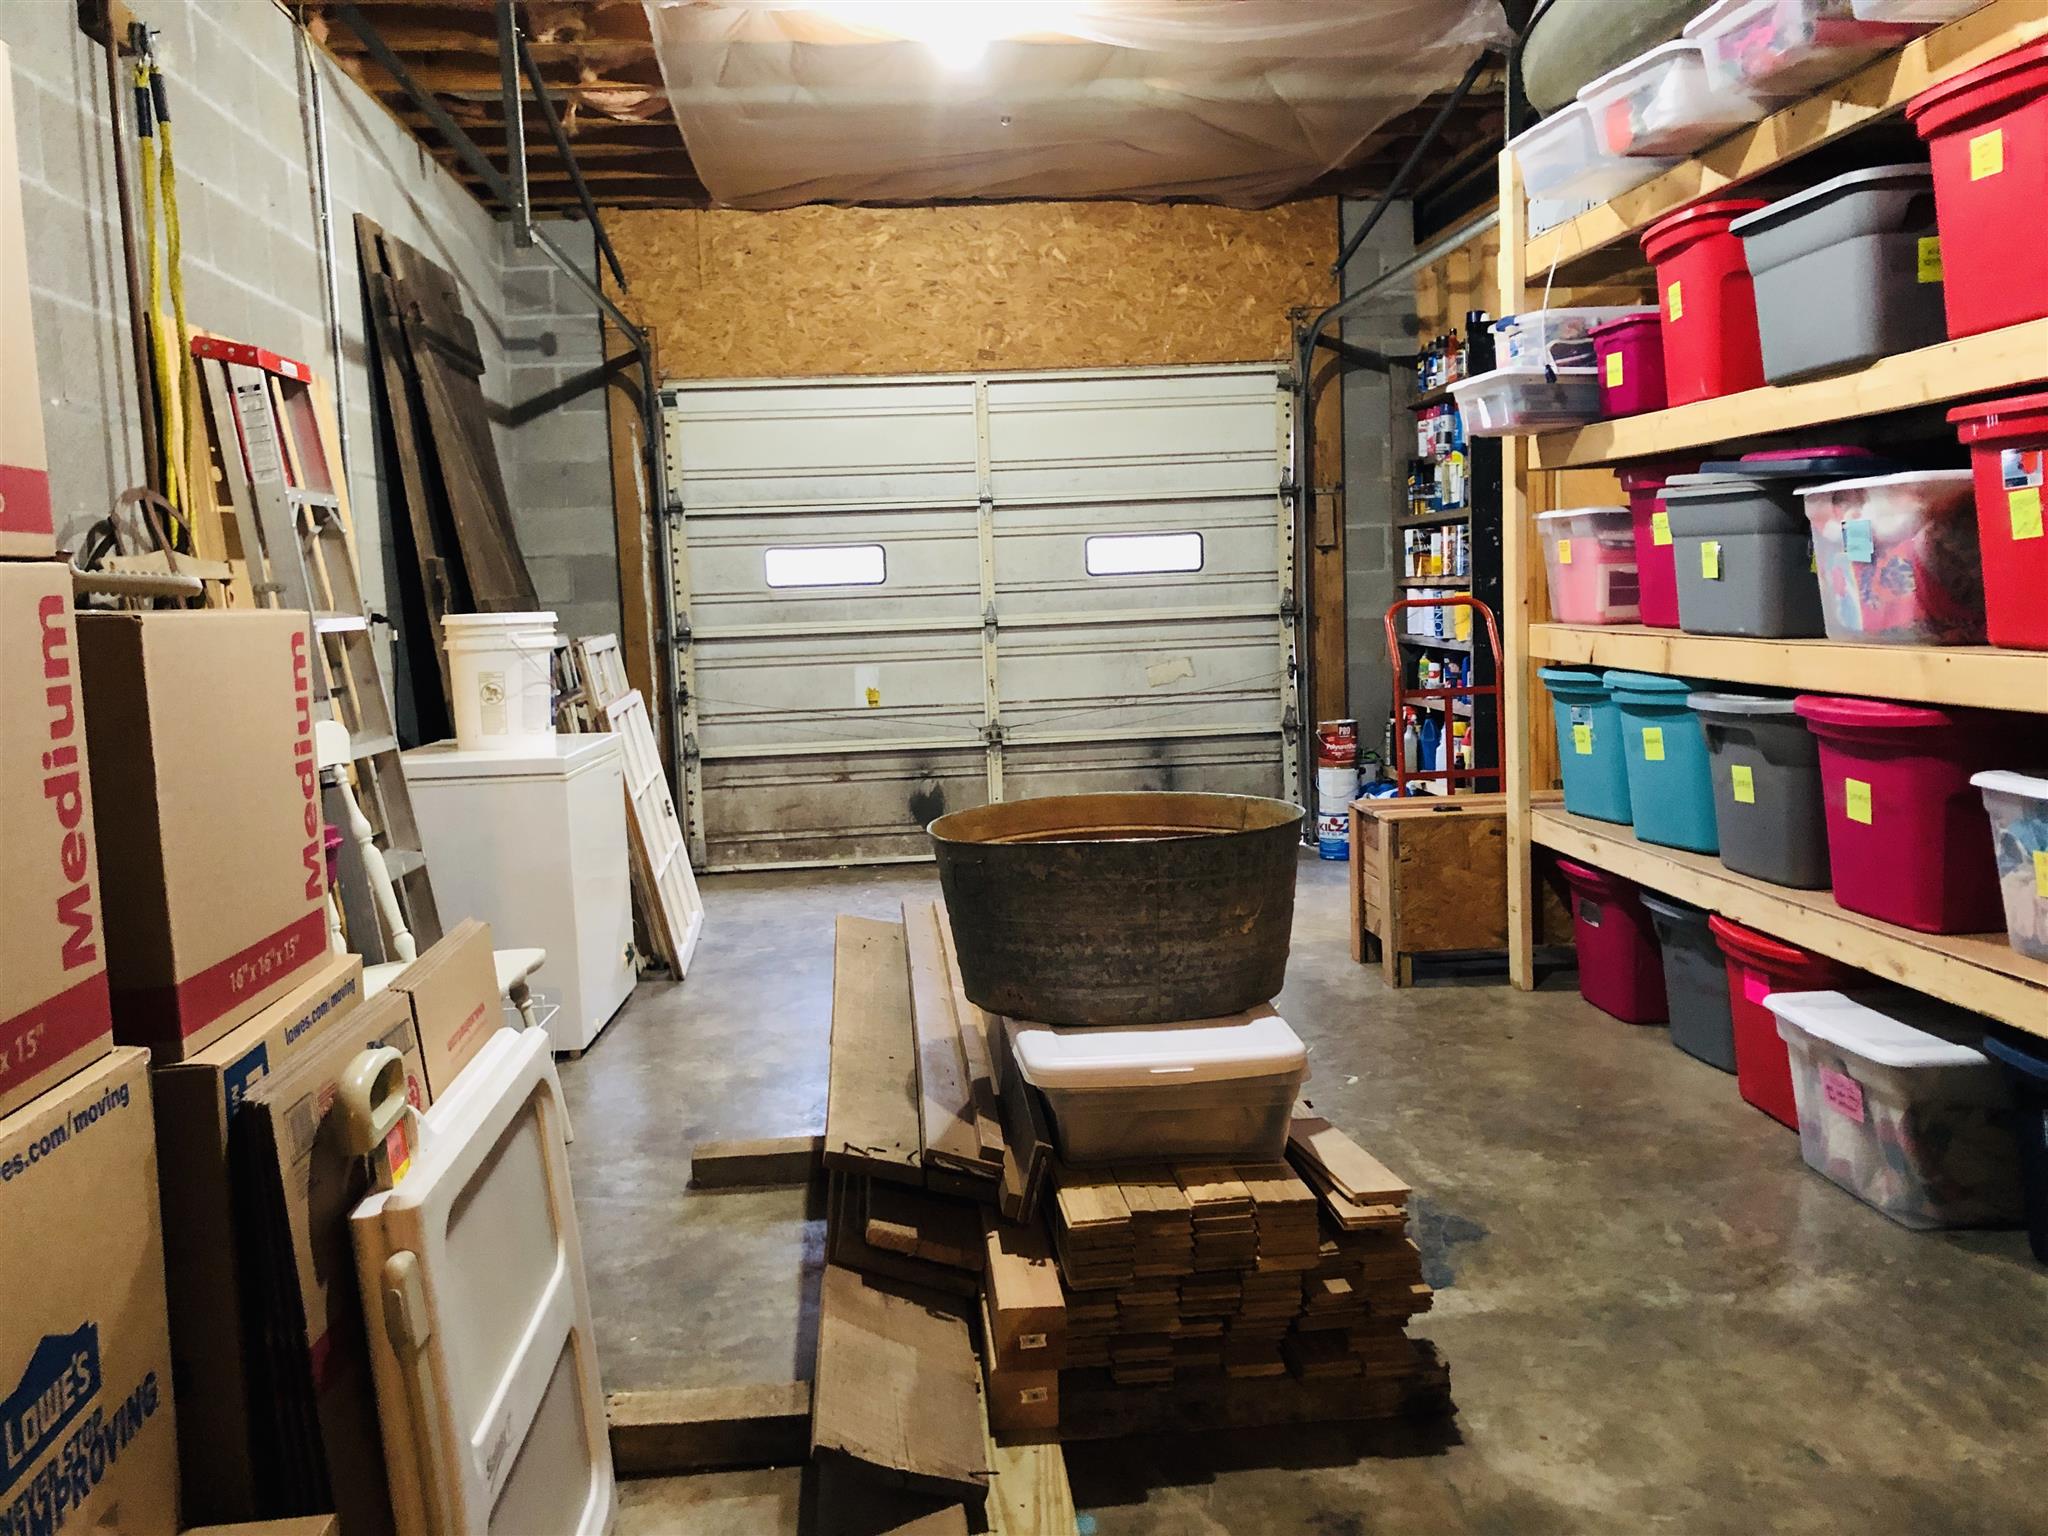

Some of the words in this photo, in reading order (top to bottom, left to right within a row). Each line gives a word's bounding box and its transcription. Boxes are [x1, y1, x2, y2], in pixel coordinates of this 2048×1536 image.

[38, 594, 97, 972] Medium
[291, 631, 324, 901] Medium
[284, 977, 357, 1046] lowes.com/moving
[0, 1082, 131, 1182] es.com/moving
[4, 1351, 92, 1470] LOWE'S
